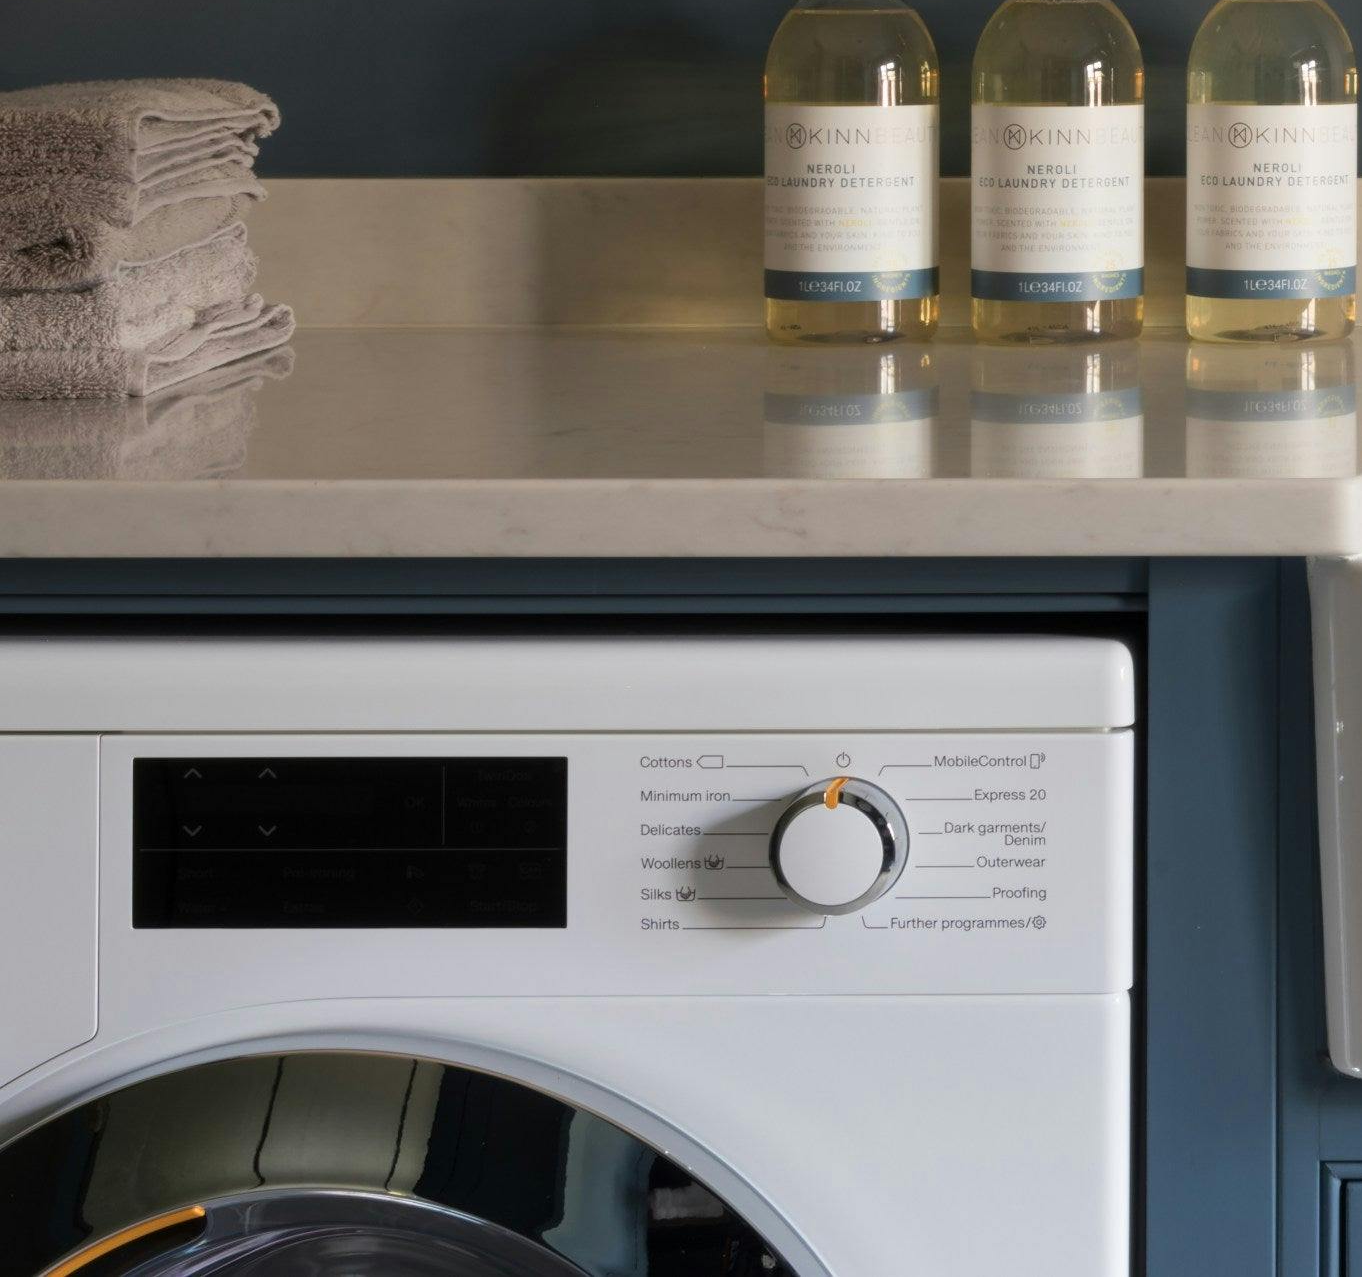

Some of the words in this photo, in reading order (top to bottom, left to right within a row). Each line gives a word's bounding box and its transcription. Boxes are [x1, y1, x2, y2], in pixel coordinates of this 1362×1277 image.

[810, 128, 870, 144] KINN
[1030, 129, 1091, 145] KINN
[1256, 127, 1315, 144] KINN
[807, 164, 856, 174] NEROLI
[1027, 164, 1077, 174] NEROLI
[1253, 163, 1302, 173] NEROLI
[781, 177, 835, 187] LAUNDRY
[840, 176, 915, 187] DETERGENT
[979, 177, 995, 187] ECO
[998, 178, 1056, 188] LAUNDRY
[1062, 176, 1130, 188] DETERGENT
[1201, 175, 1219, 185] ECO
[1223, 176, 1282, 187] LAUNDRY
[1288, 175, 1349, 186] DETERGENT
[640, 755, 692, 769] Cottons
[934, 754, 1028, 768] MobileControl
[640, 789, 701, 803] Minimum
[704, 789, 731, 803] iron
[974, 789, 1027, 805] Express
[1029, 789, 1047, 801] 20
[640, 823, 702, 836] Delicates
[944, 821, 973, 835] Dark
[975, 822, 1047, 838] garments/
[1004, 835, 1046, 847] Denim
[640, 857, 702, 870] Woollens
[976, 856, 1046, 868] Outerwear
[640, 888, 672, 901] Silks
[992, 886, 1047, 902] Proofing
[640, 918, 680, 931] Shirts
[890, 916, 938, 930] Further
